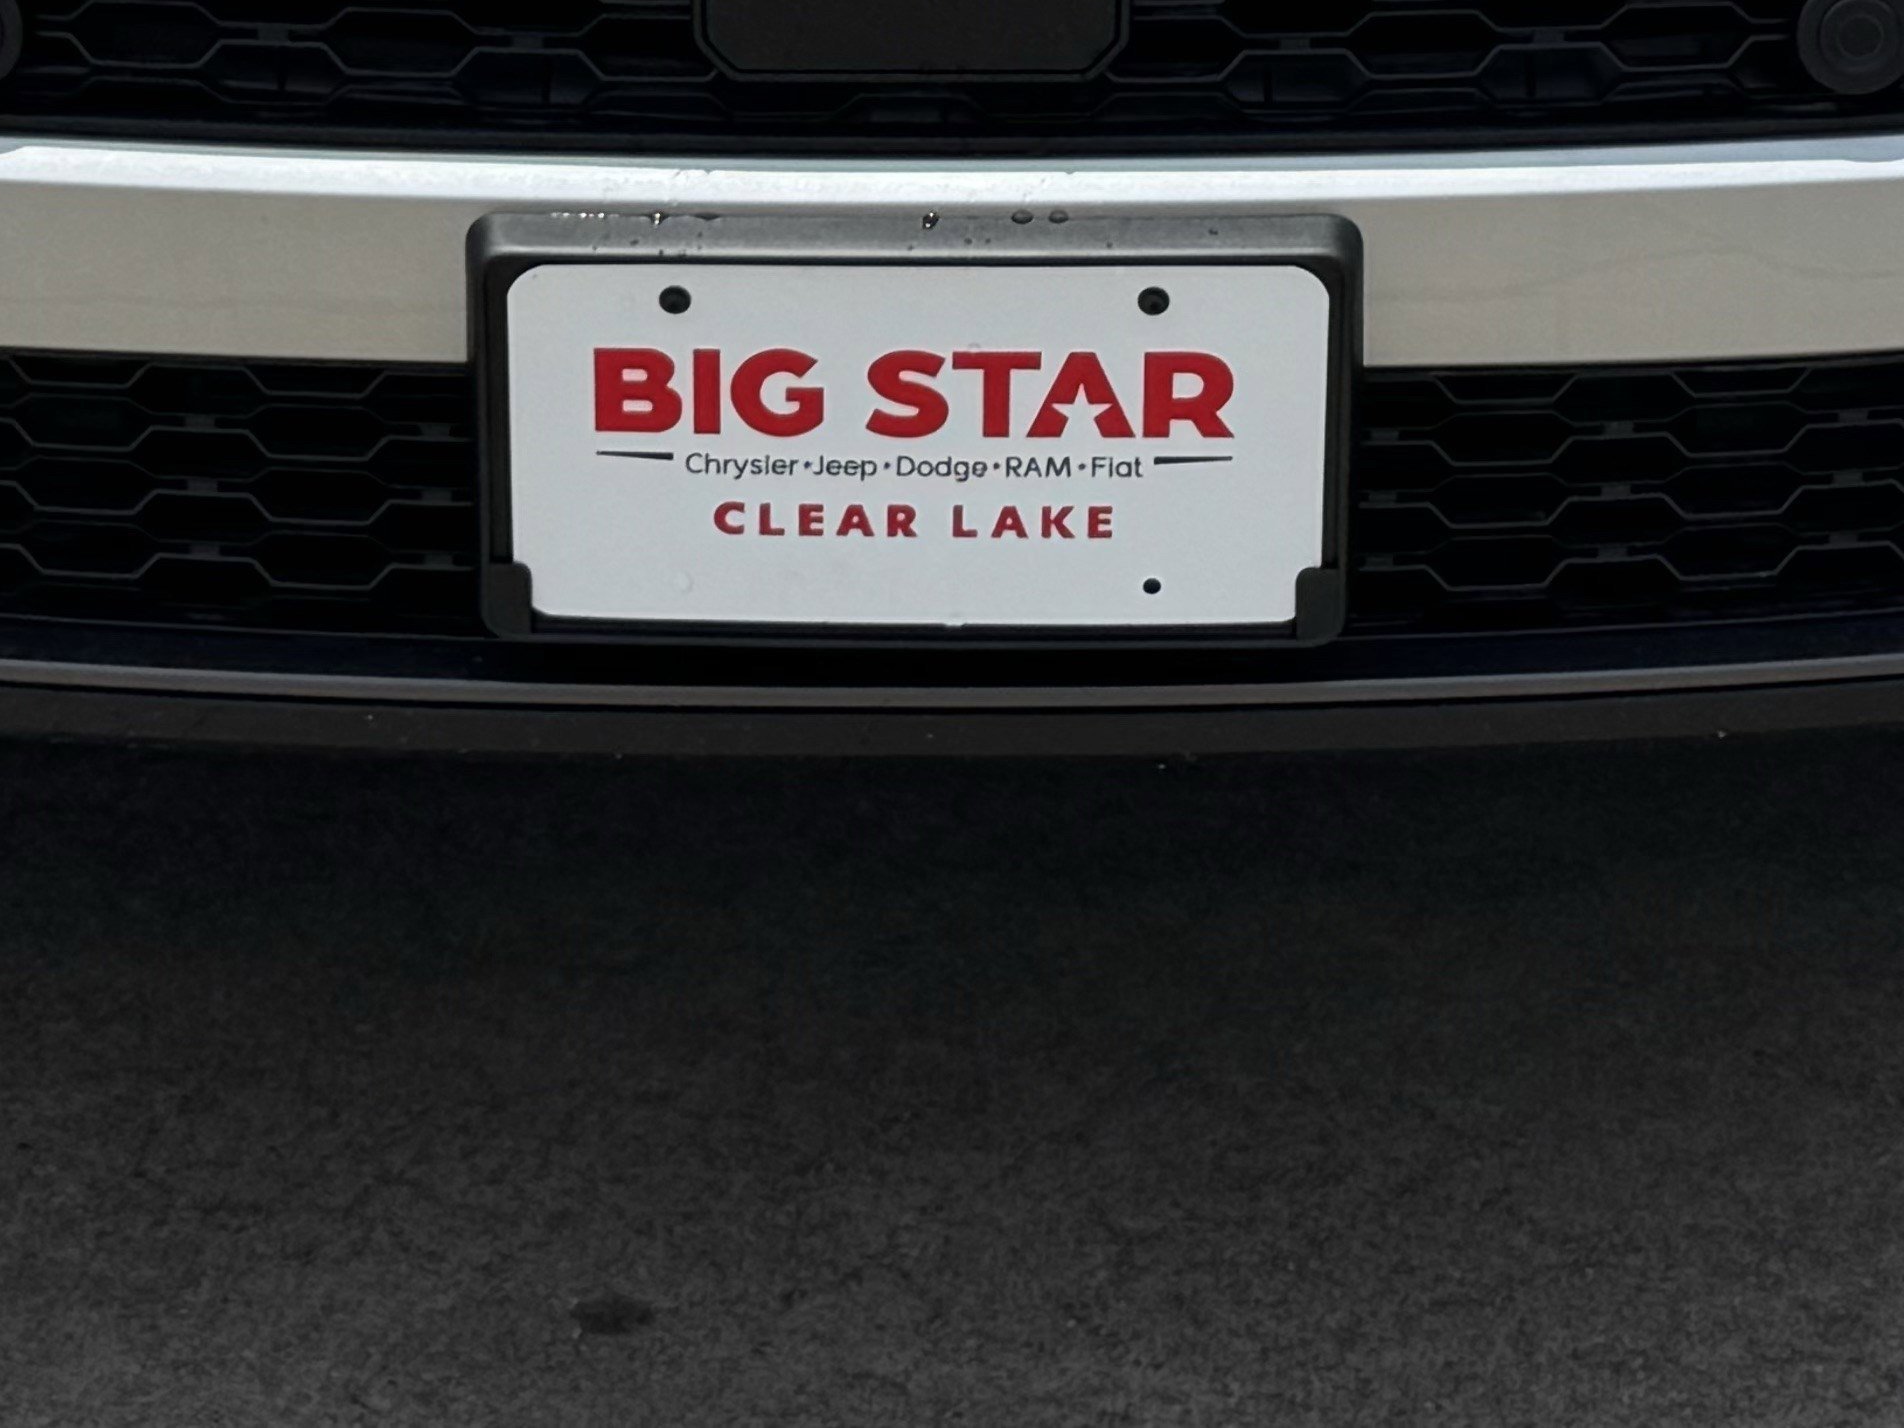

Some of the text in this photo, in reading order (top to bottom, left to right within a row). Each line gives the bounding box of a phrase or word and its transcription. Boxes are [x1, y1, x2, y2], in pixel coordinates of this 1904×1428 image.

[593, 348, 1235, 439] BIG STAR
[684, 451, 1144, 483] Chrysler Jeep Dodge RAM Fiat
[713, 501, 1114, 539] CLEAR LAKE
